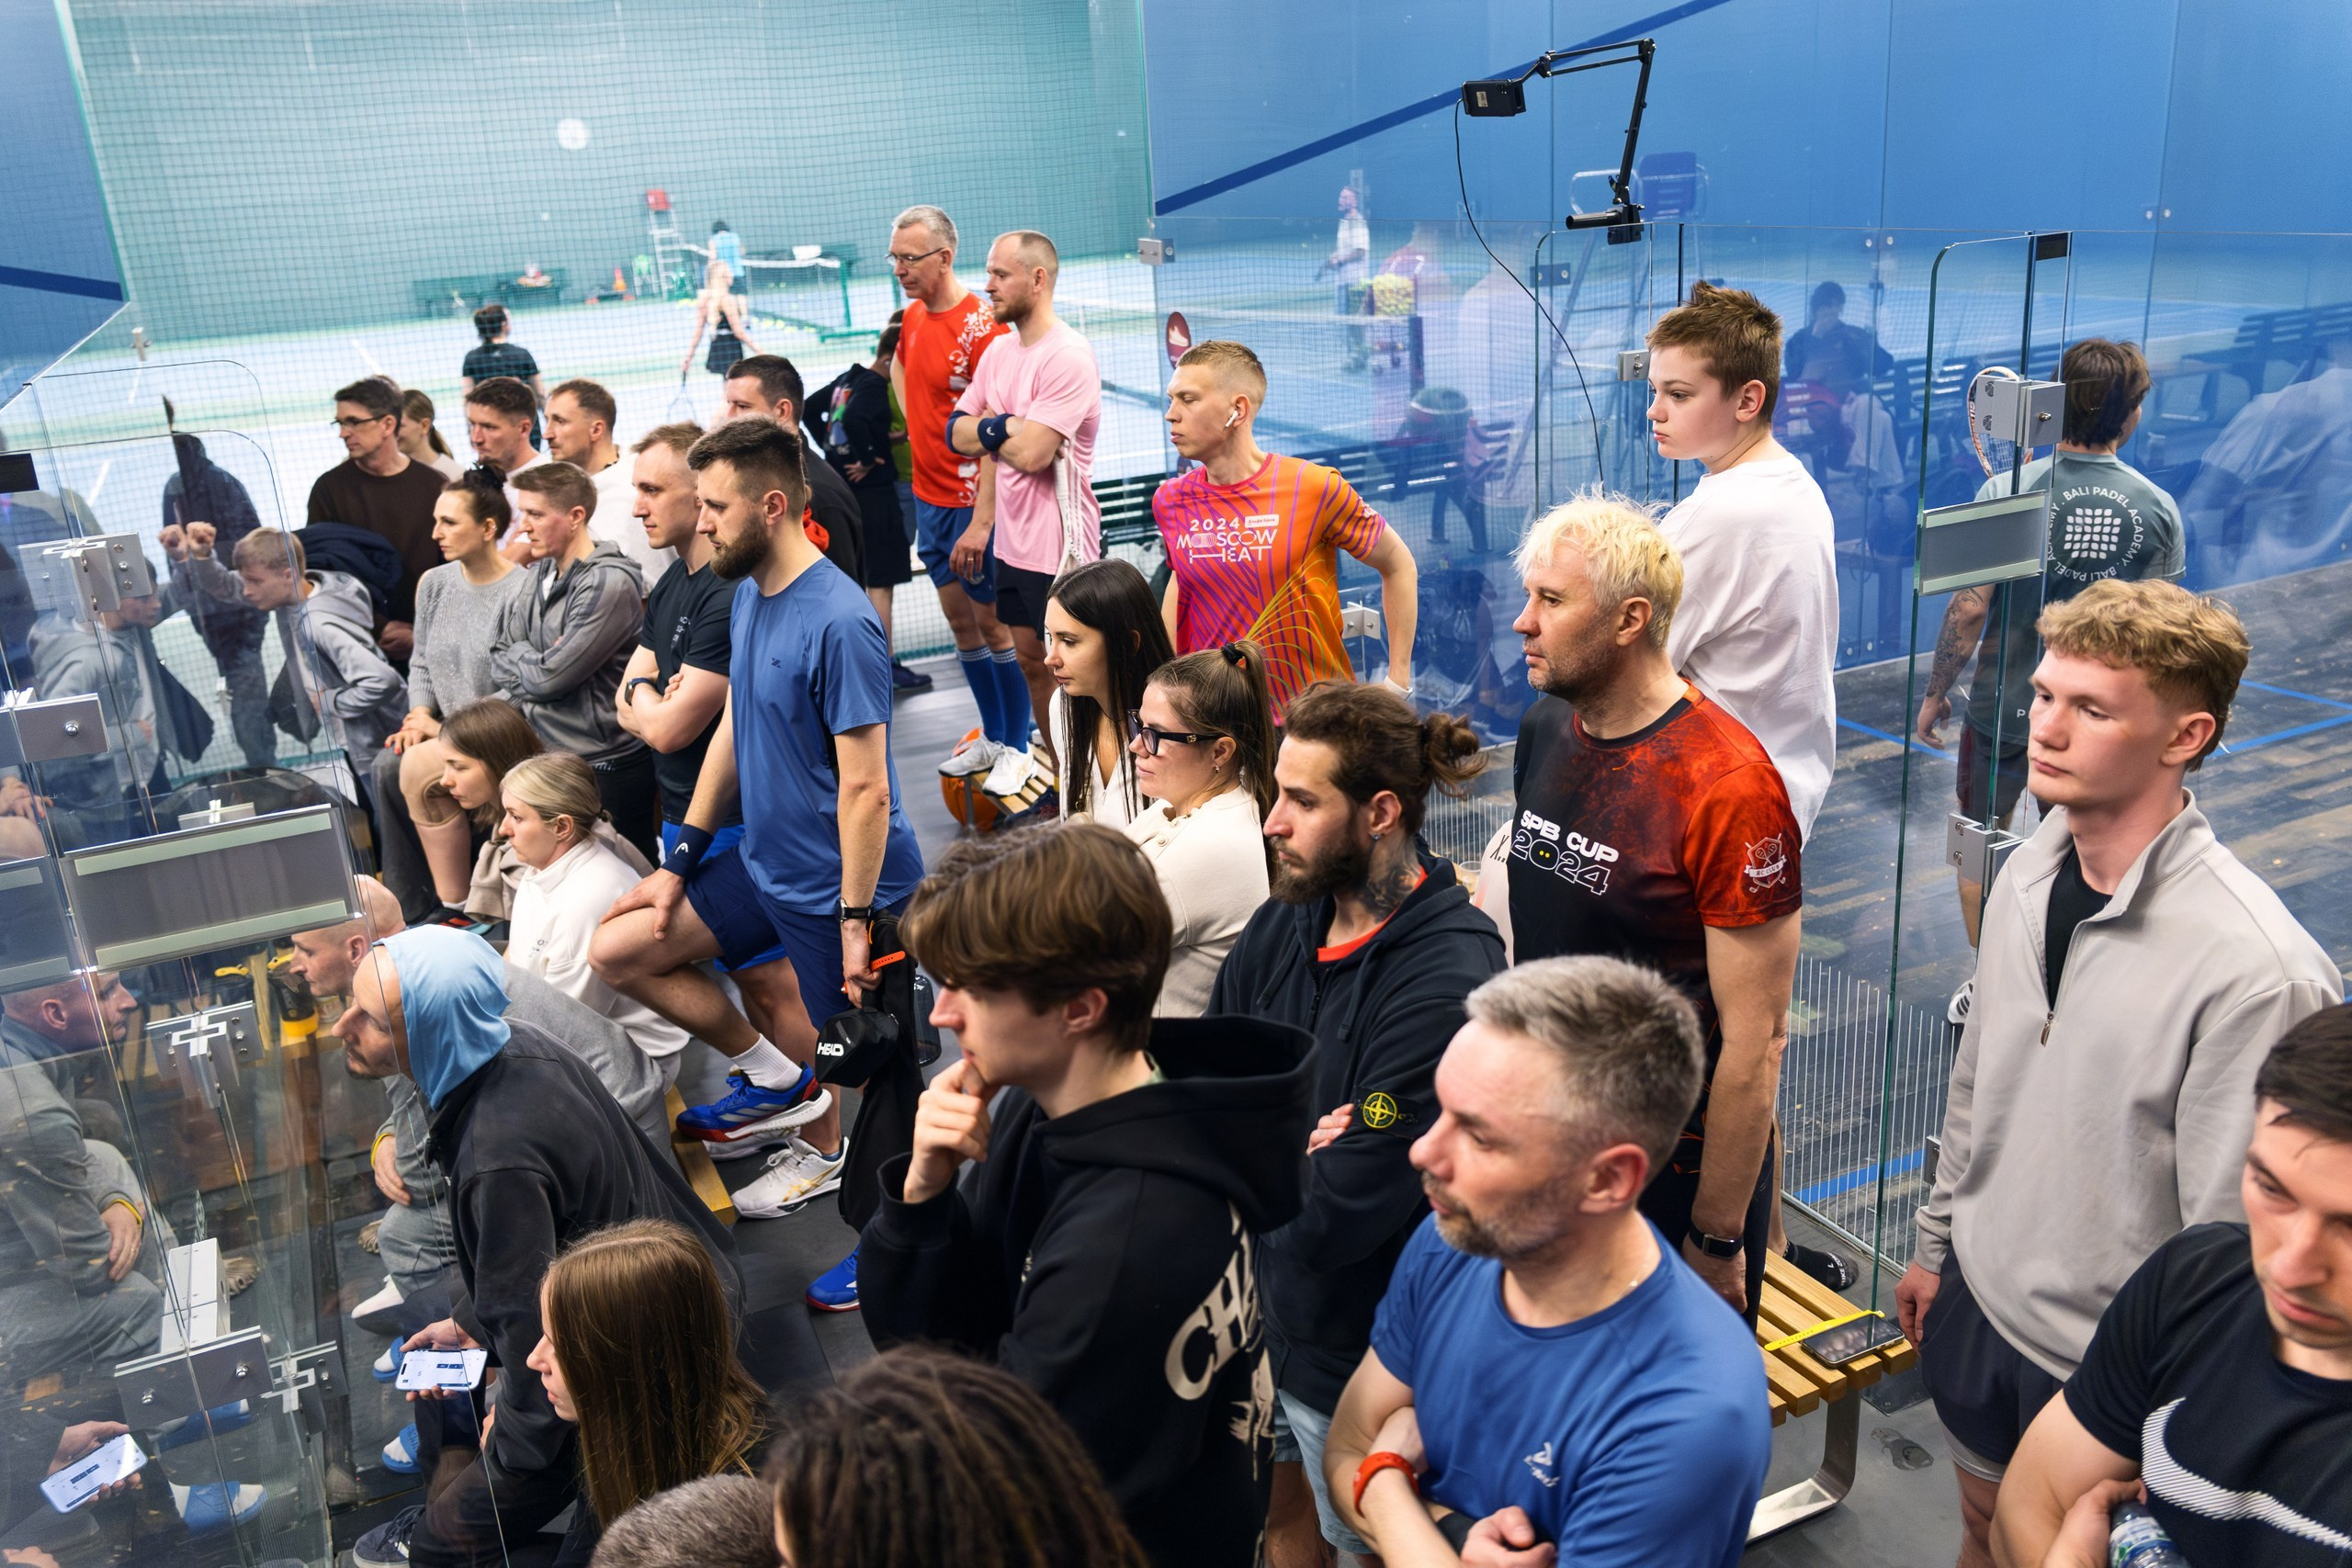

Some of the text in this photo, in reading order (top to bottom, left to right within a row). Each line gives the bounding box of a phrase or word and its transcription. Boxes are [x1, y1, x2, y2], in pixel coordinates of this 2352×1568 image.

[1189, 517, 1240, 532] 2024
[2063, 486, 2144, 567] BALI PADEL ACADEMY
[1176, 529, 1278, 549] MOSCOW
[1189, 546, 1272, 564] HEAT
[2054, 561, 2087, 582] PADEL
[1521, 809, 1620, 863] SPB CUP
[1510, 829, 1611, 896] 2024
[1766, 864, 1780, 874] CLUB
[817, 1042, 844, 1056] HEAD
